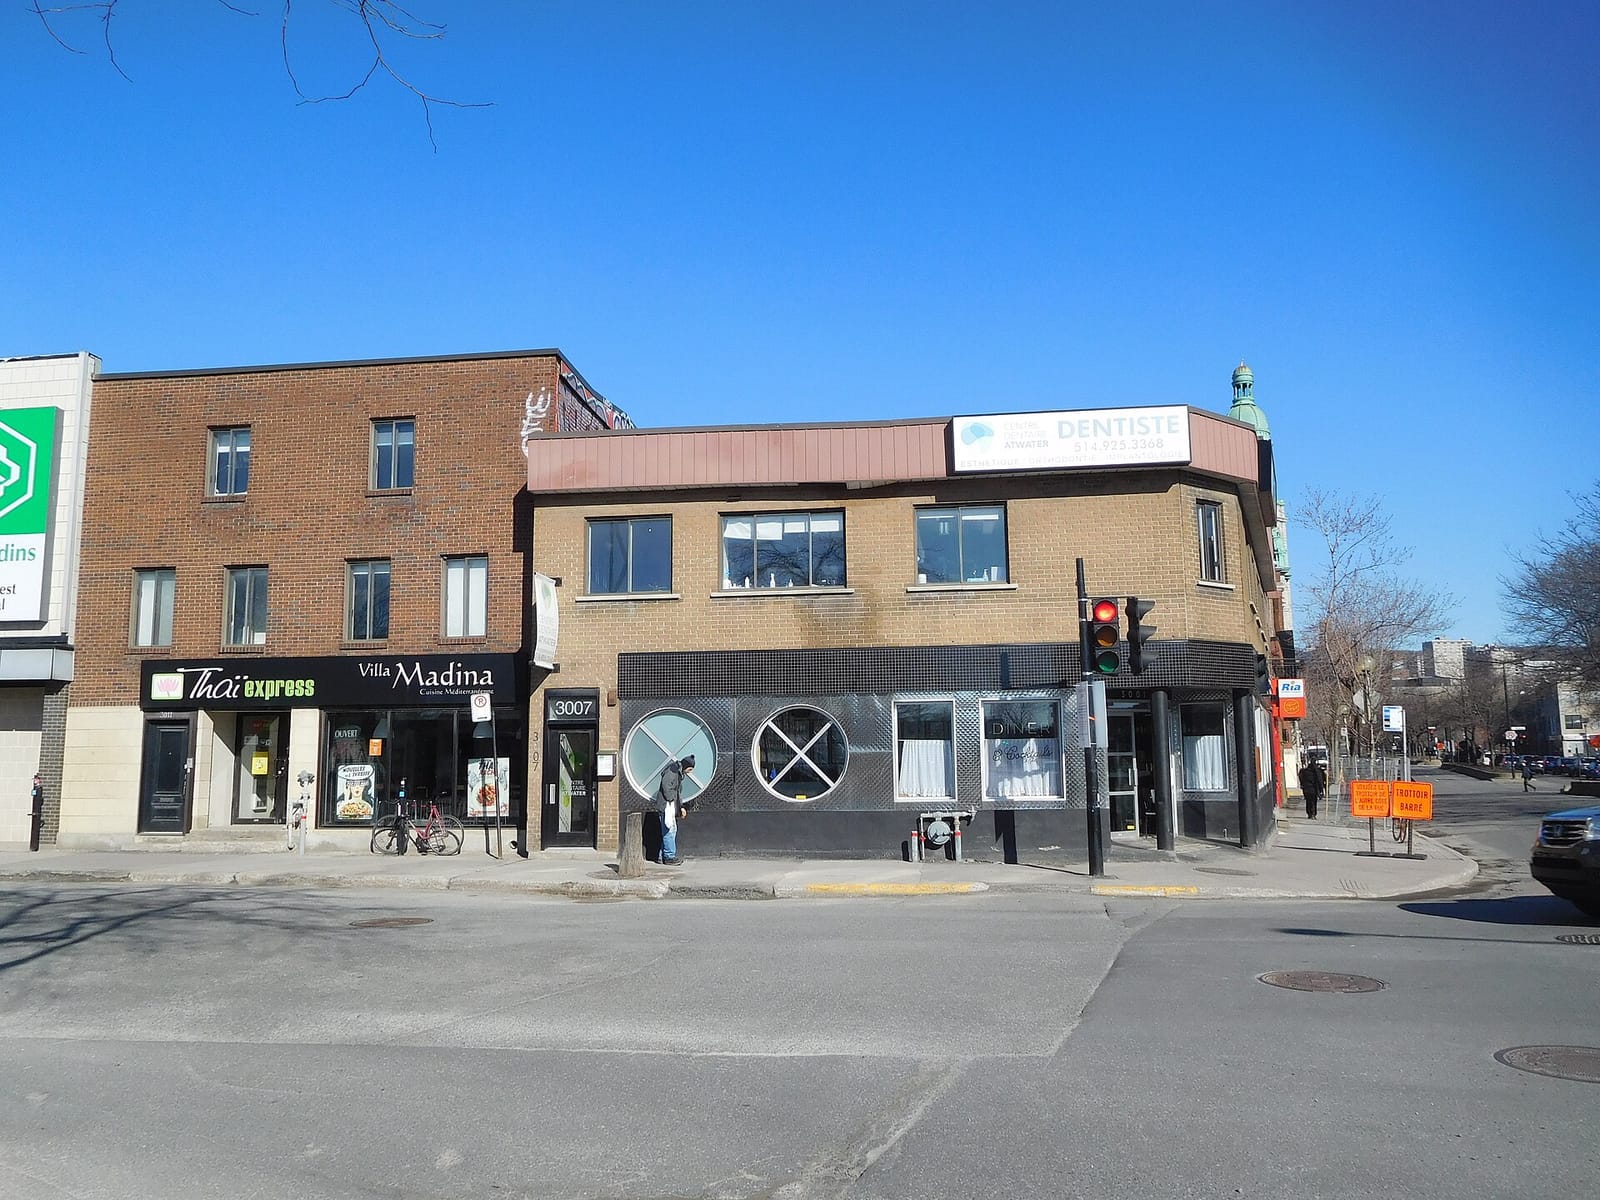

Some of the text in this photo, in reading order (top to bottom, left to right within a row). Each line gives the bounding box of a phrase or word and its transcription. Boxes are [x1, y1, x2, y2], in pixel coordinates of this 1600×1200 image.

[1057, 415, 1180, 439] DENTISTE
[1004, 440, 1049, 449] ATWATER
[1074, 438, 1164, 452] 514.925.3368
[358, 661, 494, 689] Villa Madina
[244, 679, 315, 700] express
[1282, 681, 1301, 691] Ria
[555, 701, 592, 715] 3007
[334, 729, 358, 738] OUVERT
[992, 722, 1050, 735] DINER
[1396, 788, 1429, 799] TROTTOIR
